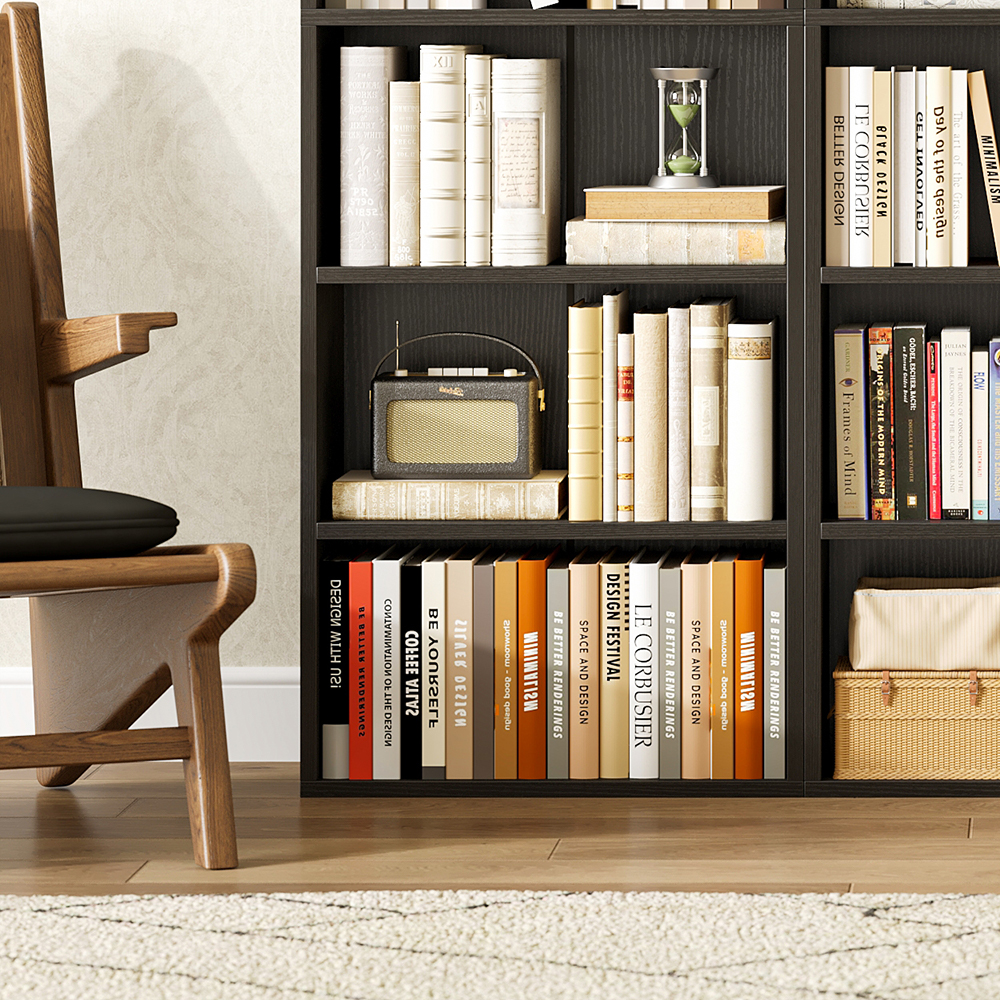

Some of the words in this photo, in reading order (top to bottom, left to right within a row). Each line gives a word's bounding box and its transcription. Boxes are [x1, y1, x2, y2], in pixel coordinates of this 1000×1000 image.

[974, 372, 985, 391] FLOW
[842, 392, 855, 442] Frames
[843, 446, 851, 458] of
[843, 461, 856, 496] Mind
[606, 573, 620, 621] DESIGN
[634, 604, 652, 627] LE
[770, 611, 780, 624] BE
[606, 626, 620, 682] FESTIVAL
[691, 620, 700, 654] SPACE
[770, 627, 780, 666] BETTER
[692, 658, 700, 680] AND
[634, 634, 652, 749] CORBUSIER
[691, 685, 700, 725] DESIGN
[770, 670, 780, 739] RENDERINGS
